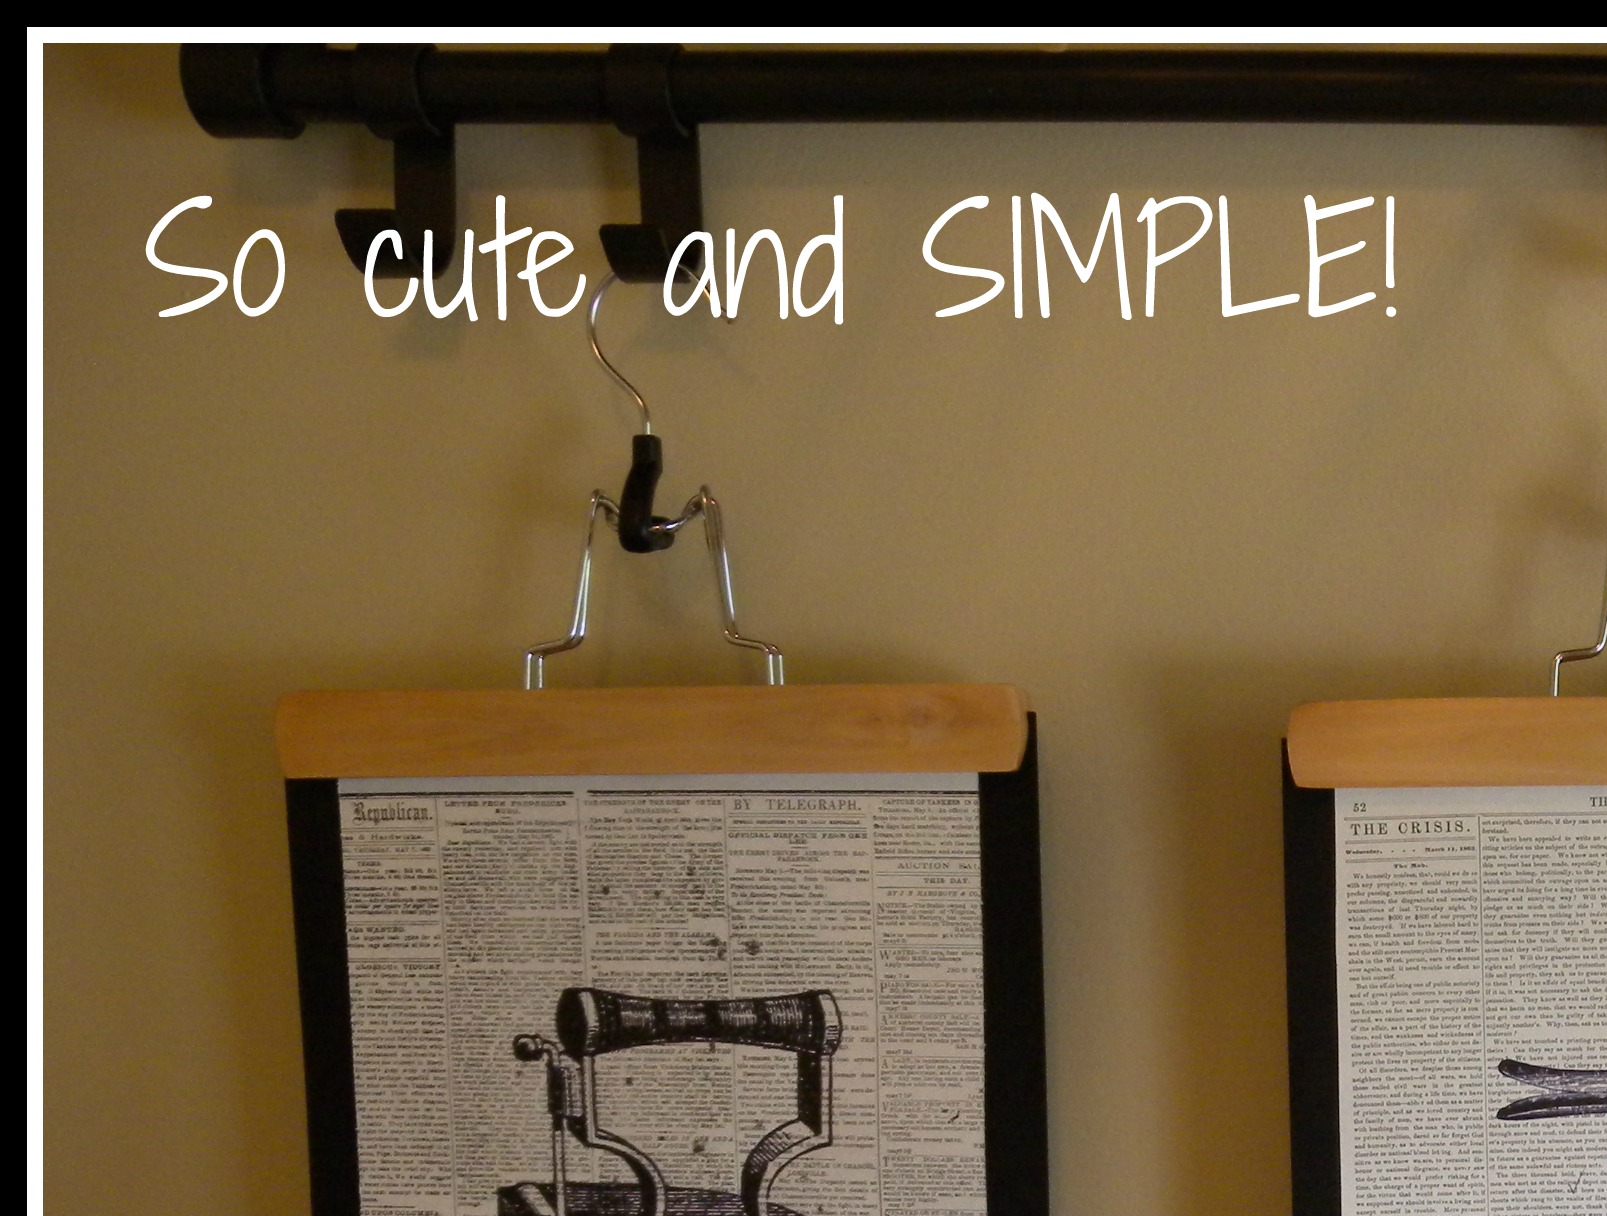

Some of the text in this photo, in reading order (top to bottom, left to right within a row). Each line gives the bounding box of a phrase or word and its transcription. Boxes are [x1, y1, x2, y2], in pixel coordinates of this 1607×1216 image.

[734, 800, 861, 810] BY TELEGRAPH.
[1353, 803, 1367, 812] 52
[1351, 821, 1471, 836] THE CRISIS.
